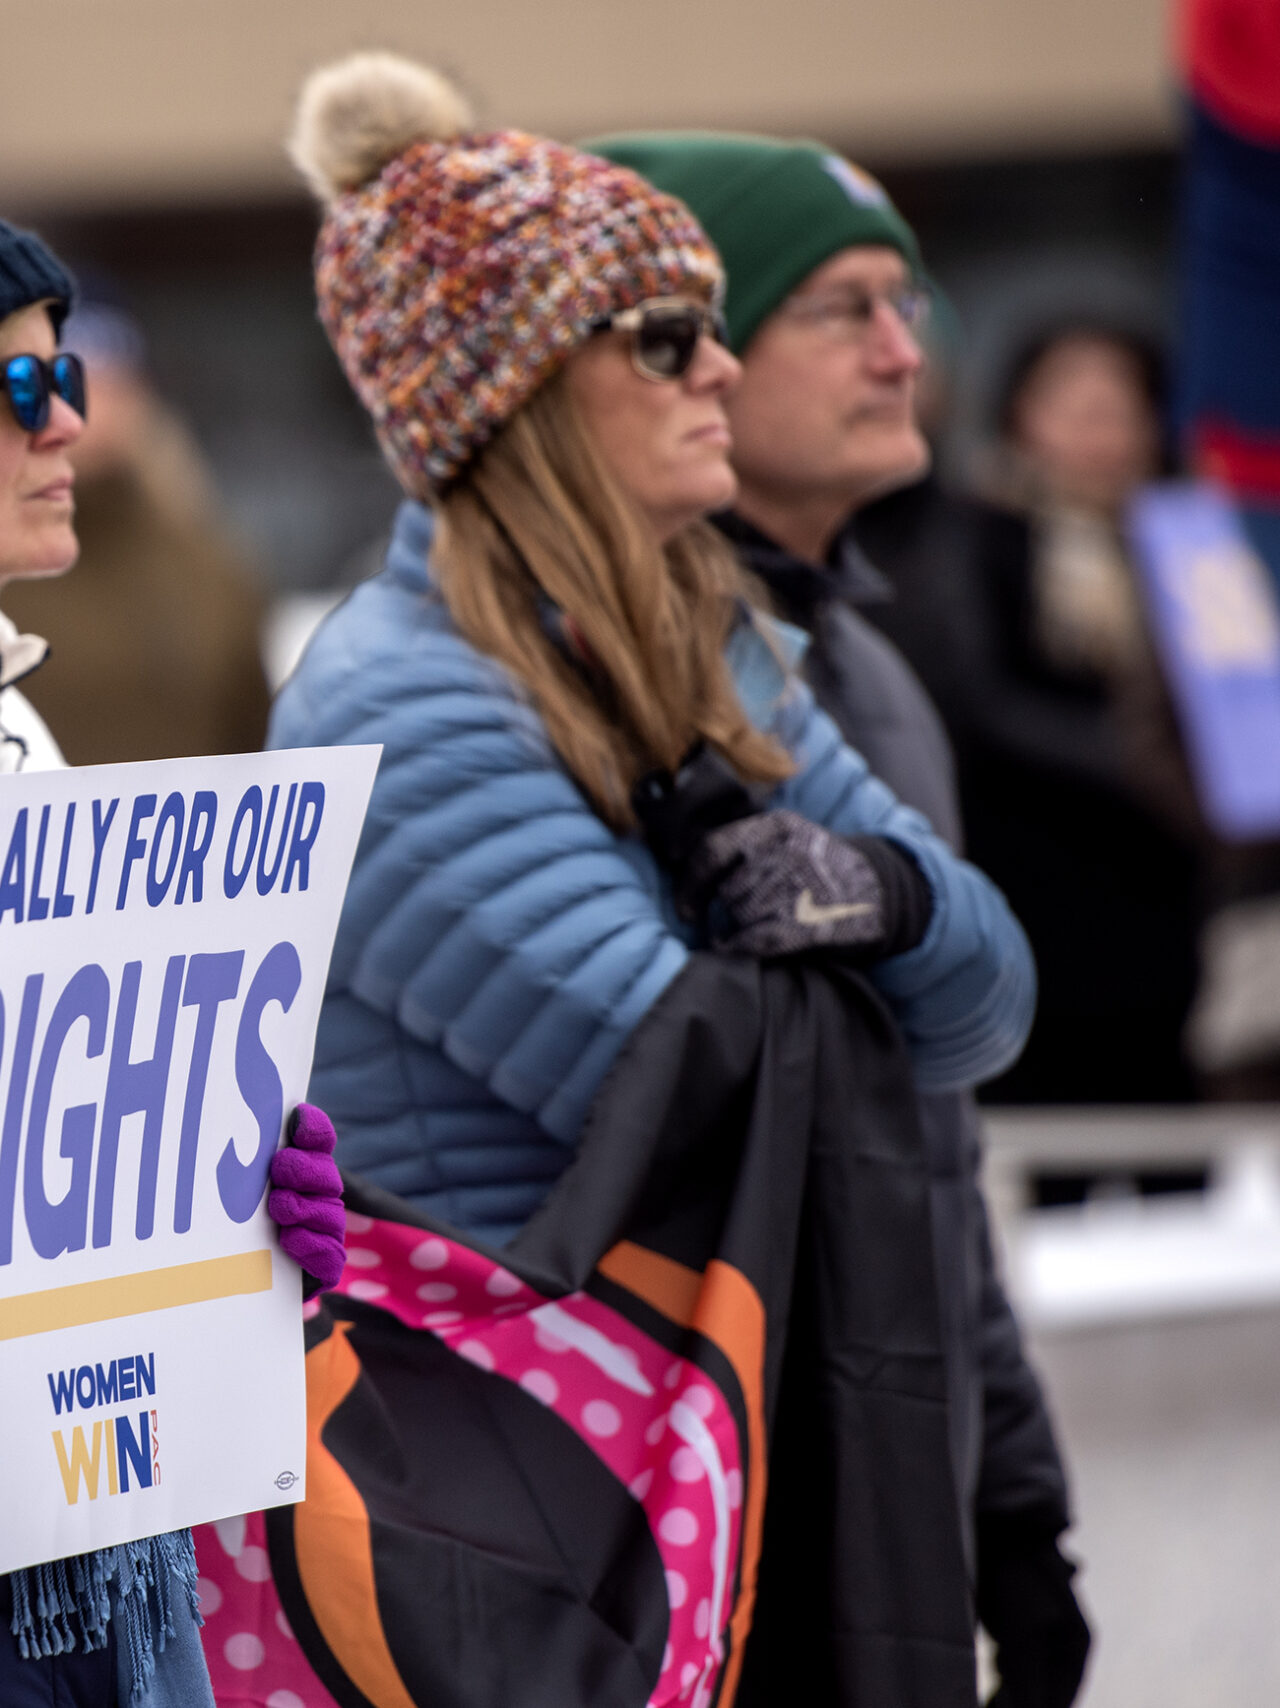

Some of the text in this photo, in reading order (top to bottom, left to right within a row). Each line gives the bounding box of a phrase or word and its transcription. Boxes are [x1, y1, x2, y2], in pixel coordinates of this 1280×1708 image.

[115, 790, 218, 911] FOR
[223, 781, 326, 900] OUR
[48, 1352, 156, 1416] WOMEN
[51, 1410, 153, 1506] WIN
